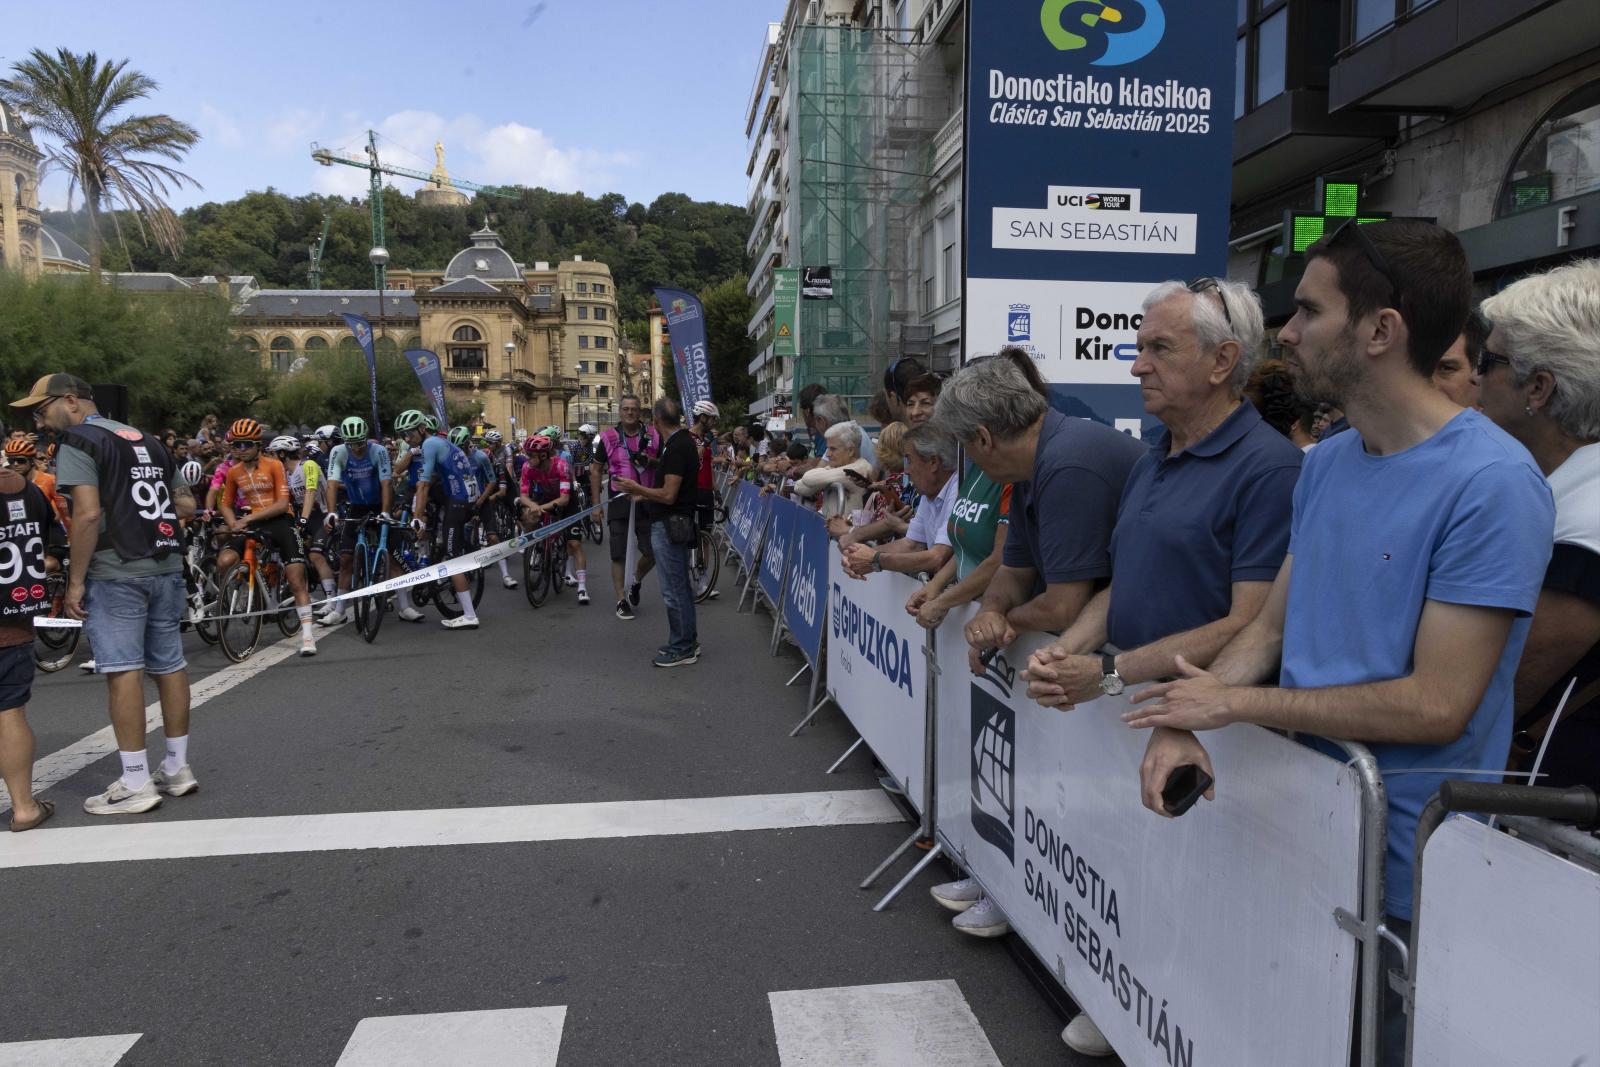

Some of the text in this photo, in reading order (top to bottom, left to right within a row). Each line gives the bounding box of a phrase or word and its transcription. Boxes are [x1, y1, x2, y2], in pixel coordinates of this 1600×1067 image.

[989, 69, 1211, 110] Donostiako klasikoa
[989, 102, 1210, 134] Clásica San Sebastián 2025
[1057, 195, 1083, 207] UCI
[1010, 220, 1178, 242] SAN SEBASTIÁN
[130, 466, 164, 479] STAFF
[132, 480, 177, 520] 92
[0, 537, 47, 585] 93
[841, 596, 913, 698] GIPUZKOA
[1025, 806, 1121, 938] DONOSTIA
[1025, 859, 1194, 1067] SAN SEBASTIÁN
